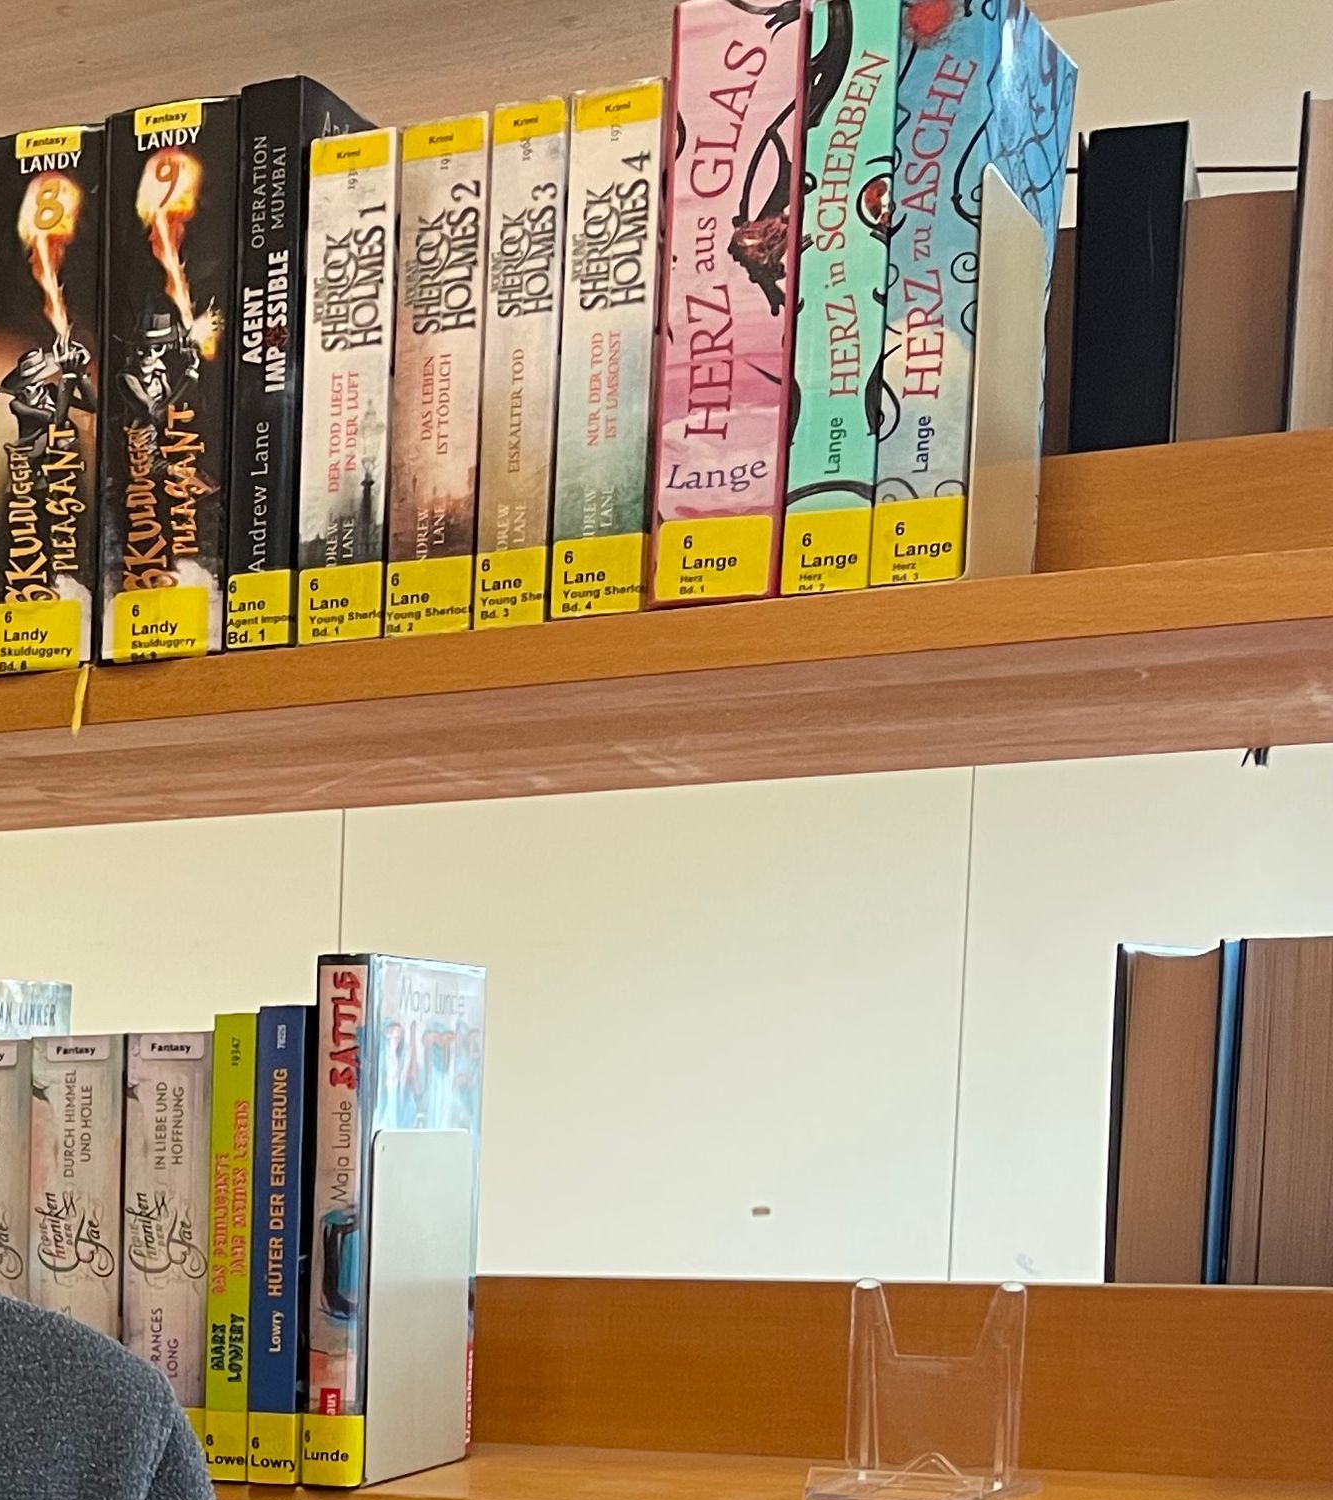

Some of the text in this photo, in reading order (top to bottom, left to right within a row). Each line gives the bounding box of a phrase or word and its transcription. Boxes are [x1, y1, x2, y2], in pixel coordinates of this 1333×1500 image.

[137, 127, 200, 152] LANDY
[154, 157, 181, 207] 9
[33, 178, 65, 231] 8
[252, 136, 268, 249] OPERATION
[271, 145, 287, 230] MUMBAI
[609, 150, 652, 306] HOLMES 4
[816, 48, 891, 398] HERZ in SCHERBEN
[901, 53, 979, 400] HERZ zu ASCHE
[581, 183, 621, 311] SHERLOCK
[684, 39, 767, 441] HERZ aus GLAS
[242, 287, 266, 365] AGENT
[328, 372, 342, 492] DER TOD LIEGT
[345, 371, 358, 471] IN DER LUFT
[508, 349, 524, 473] EISKALTER TOD
[824, 416, 846, 476] Lange
[47, 423, 87, 572] PLEASANT
[247, 420, 270, 573] Andrew Lane
[666, 458, 768, 492] Lange
[682, 552, 738, 570] Lange
[683, 535, 693, 549] 6
[4, 627, 48, 643] Landy
[151, 1043, 190, 1054] Fantasy
[64, 1070, 77, 1177] DURCH HIMMEL
[81, 1132, 91, 1162] UND
[155, 1081, 167, 1170] IN LIEBE UND
[171, 1087, 184, 1165] HOFFNUNG
[330, 1100, 353, 1201] Maja Lunde
[268, 1068, 288, 1296] HÜTER DER ERINNERUNG
[269, 1309, 283, 1353] Lowry
[252, 1454, 295, 1472] Lowry
[304, 1447, 349, 1463] Lunde
